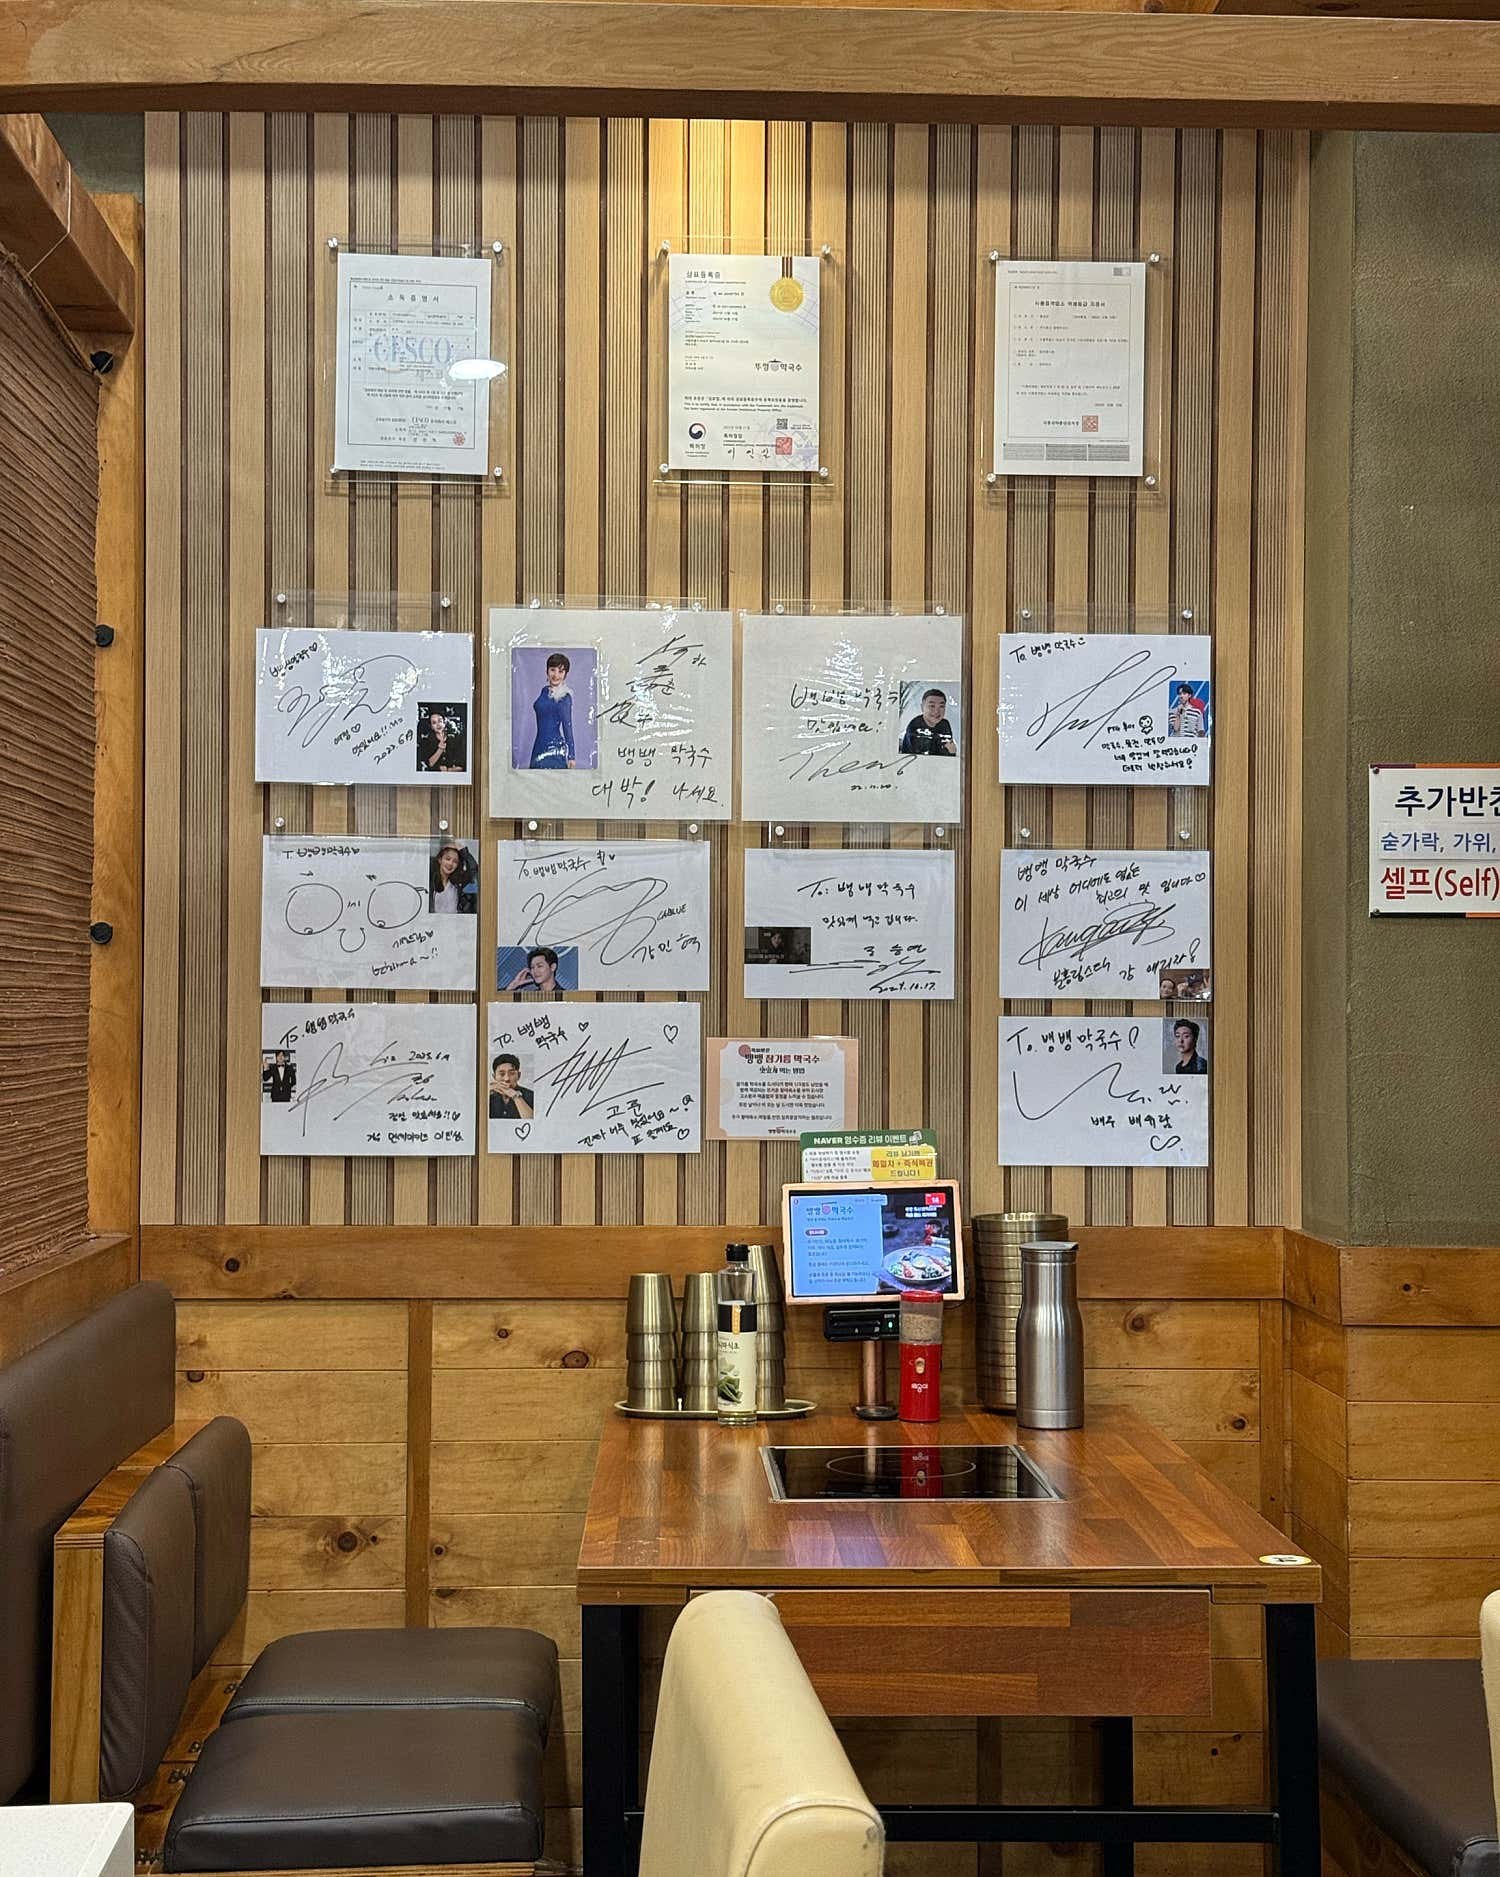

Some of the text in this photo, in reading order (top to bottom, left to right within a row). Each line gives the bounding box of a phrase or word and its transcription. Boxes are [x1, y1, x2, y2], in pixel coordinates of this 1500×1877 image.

[617, 744, 713, 769] 뱅뱅 막국수
[1381, 831, 1496, 853] 숟가락, 가위,
[1380, 866, 1500, 901] 셀프(Self)
[793, 1053, 821, 1064] 막국수
[813, 1134, 907, 1145] NAVER 영수증 리뷰 이벤트
